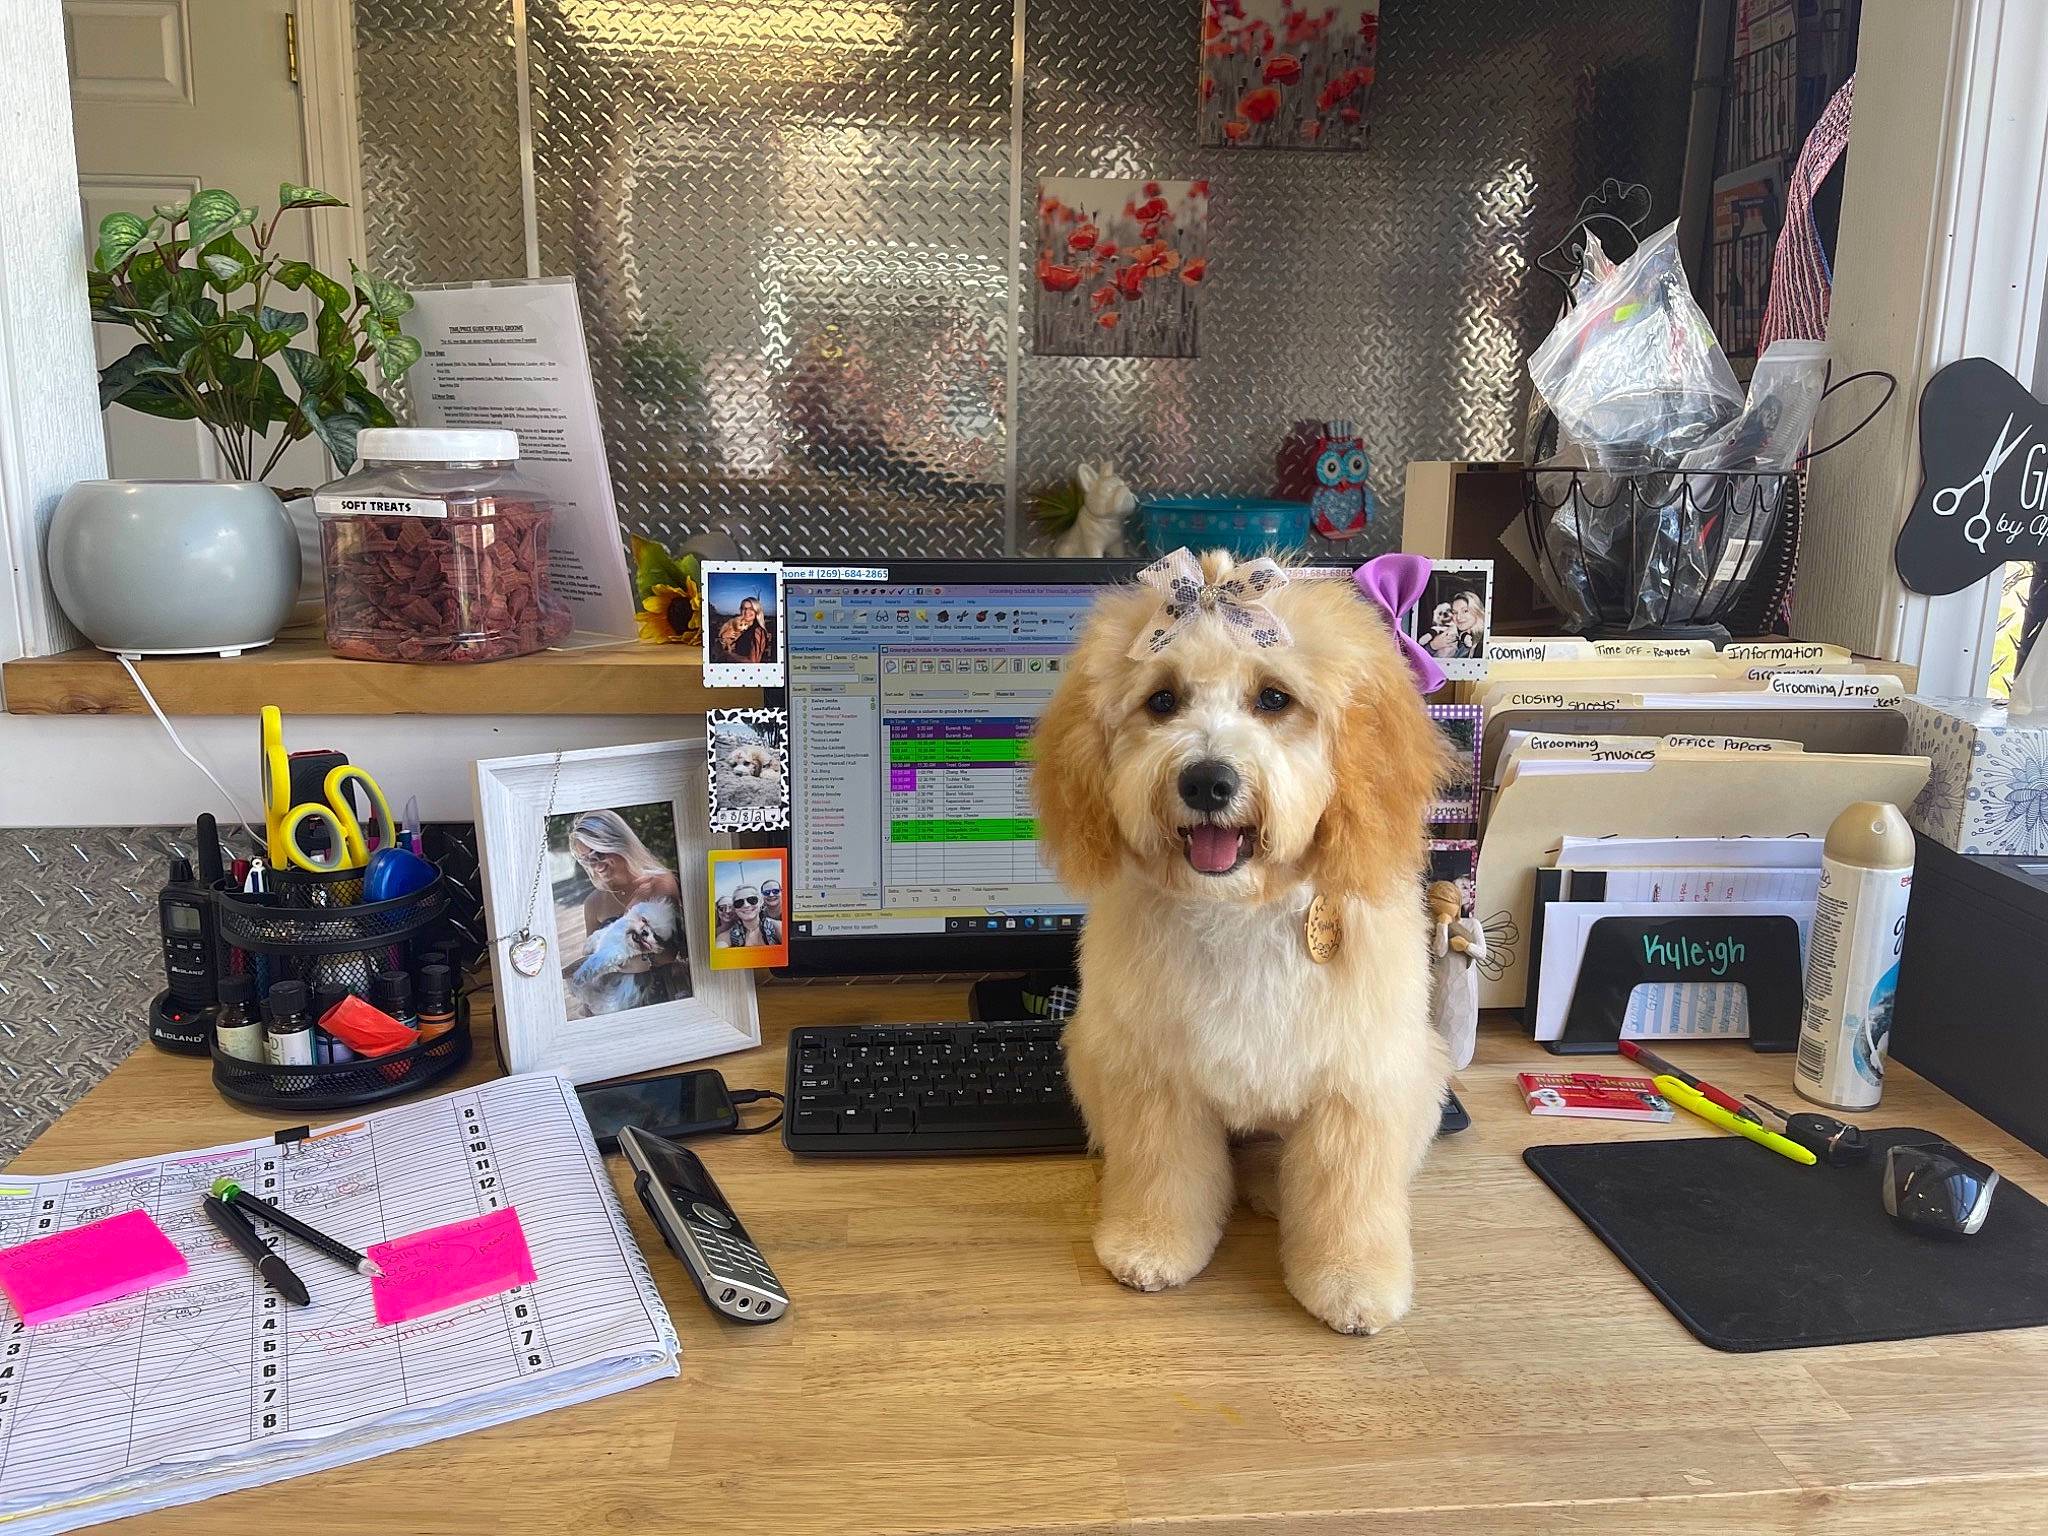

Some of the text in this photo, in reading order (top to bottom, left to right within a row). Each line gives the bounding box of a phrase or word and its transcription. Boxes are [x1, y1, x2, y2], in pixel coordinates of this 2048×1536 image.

[2021, 443, 2048, 511] G
[342, 501, 412, 512] SOFT TREATS
[1995, 513, 2025, 544] by
[809, 570, 815, 578] #
[817, 569, 888, 579] (269)-684-2865
[1596, 644, 1622, 655] Time
[1653, 648, 1691, 658] Request
[1728, 646, 1823, 660] Information
[1773, 679, 1880, 698] Grooming/Info
[1512, 694, 1564, 708] Closing
[1531, 737, 1599, 752] Grooming
[1592, 750, 1656, 762] Invoices
[1643, 934, 1745, 976] Kyleigh
[172, 966, 205, 976] MIDLAND
[155, 1028, 204, 1043] MIDLAND
[464, 1109, 475, 1118] 8
[469, 1125, 480, 1135] 9
[469, 1141, 487, 1153] 10
[263, 1161, 275, 1171] 8
[475, 1159, 490, 1171] 11
[478, 1177, 497, 1190] 12
[42, 1200, 55, 1210] 8
[489, 1197, 498, 1208] 1
[39, 1218, 51, 1229] 9
[264, 1297, 277, 1309] 3
[514, 1304, 528, 1319] 6
[262, 1319, 277, 1330] 4
[521, 1330, 533, 1346] 7
[7, 1344, 21, 1356] 3
[263, 1340, 277, 1353] 5
[527, 1355, 542, 1366] 8
[0, 1366, 15, 1378] 4
[263, 1364, 277, 1378] 6
[263, 1388, 277, 1403] 7
[263, 1413, 277, 1429] 8
